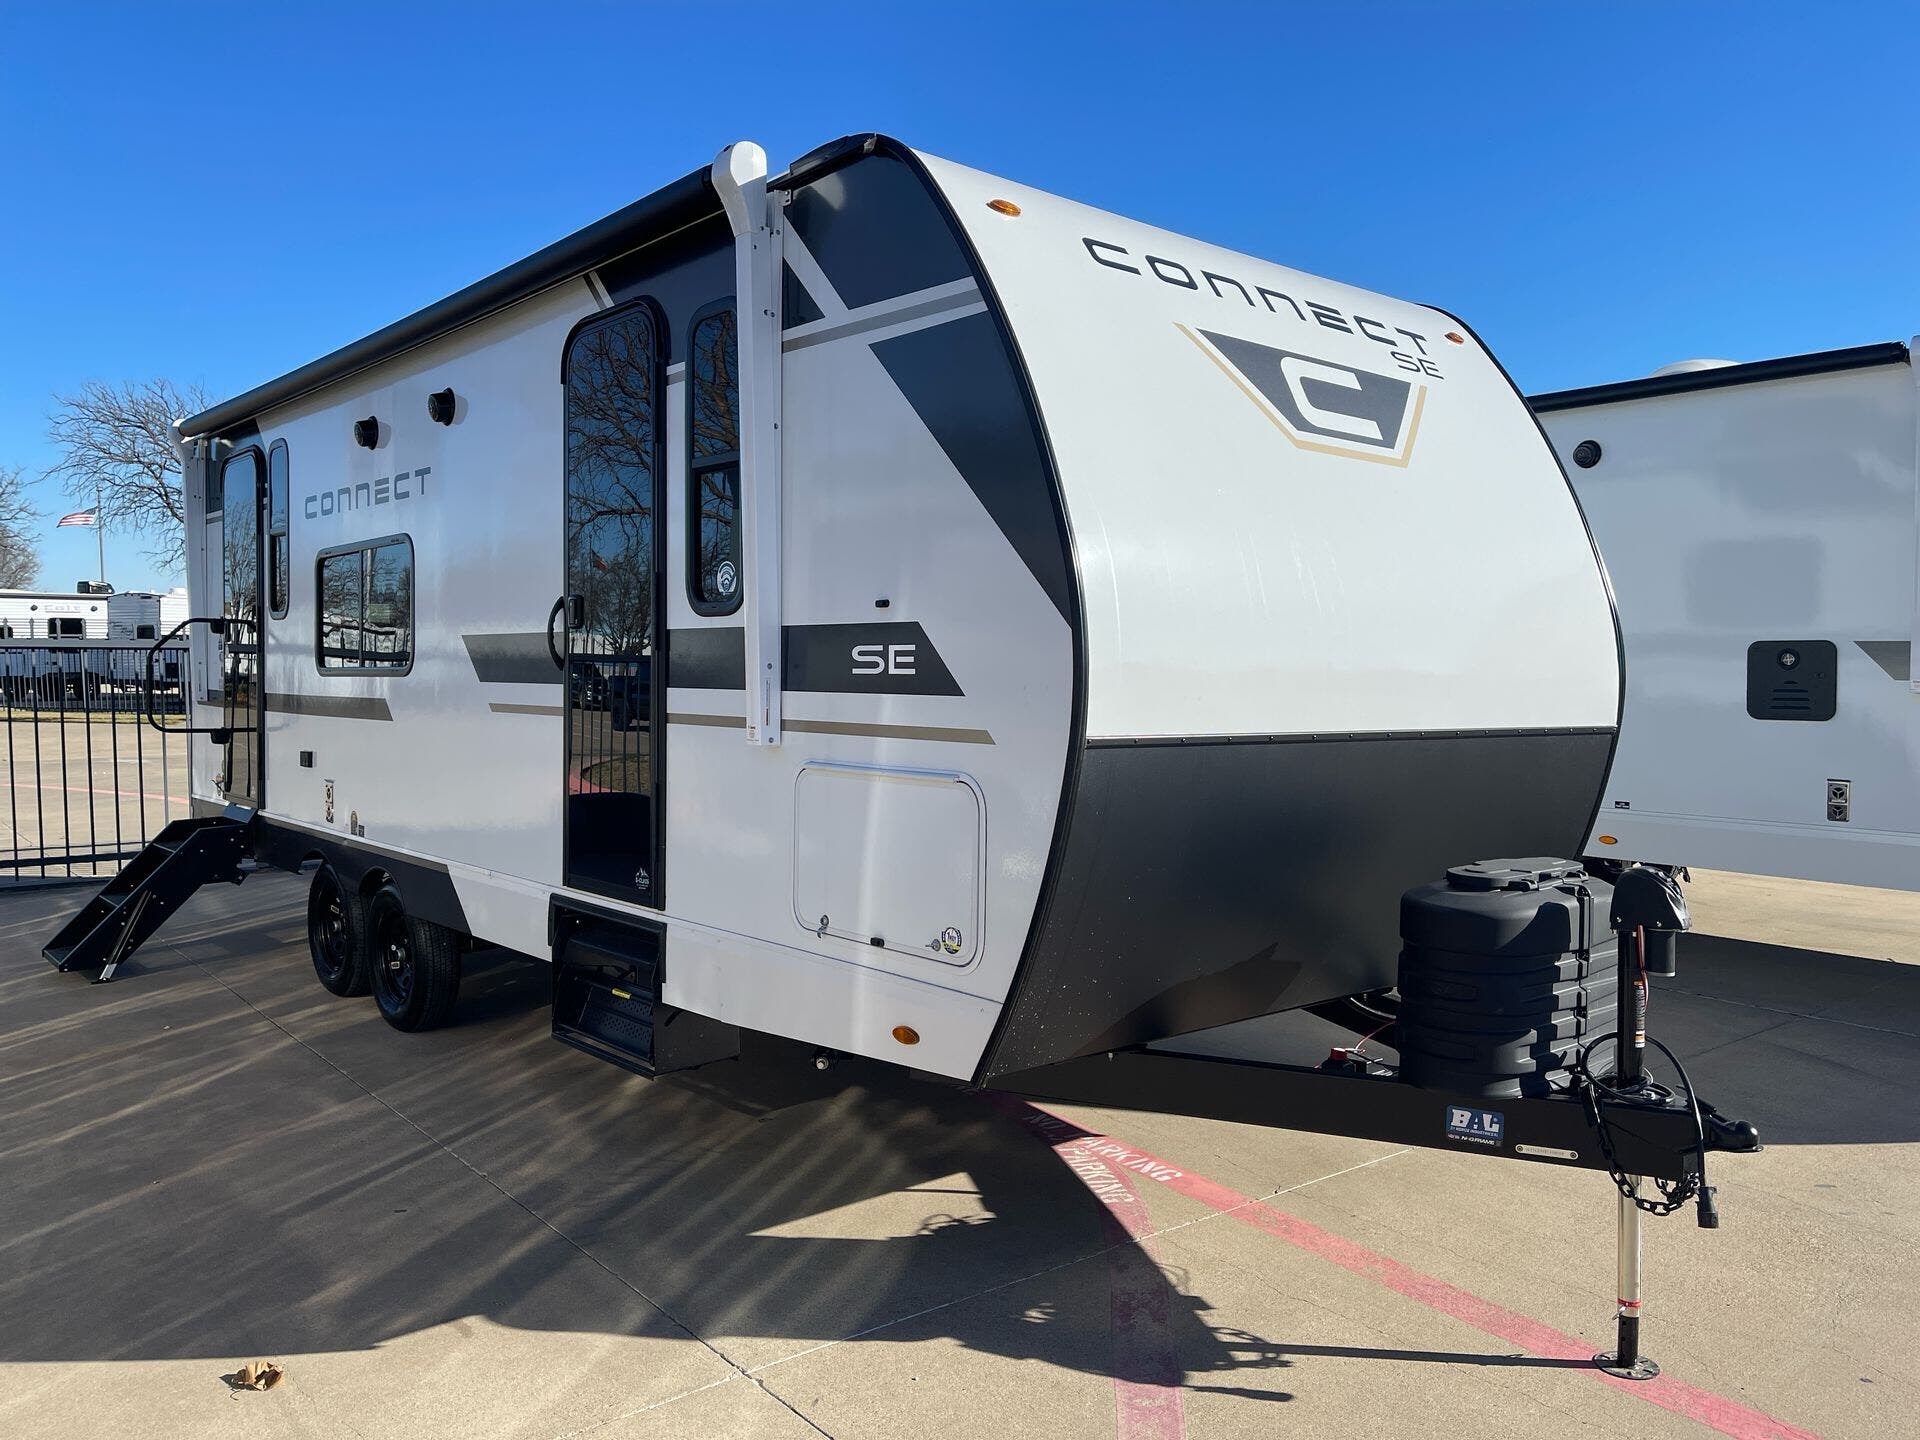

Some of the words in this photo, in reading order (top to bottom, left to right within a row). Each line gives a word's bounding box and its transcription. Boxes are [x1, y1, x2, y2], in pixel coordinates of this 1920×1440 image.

[1082, 237, 1428, 354] CONNECT
[1391, 350, 1445, 380] SE
[303, 466, 432, 519] CONNECT
[851, 644, 916, 675] SE
[1450, 1108, 1500, 1133] BAL
[1058, 1144, 1135, 1204] PARKING
